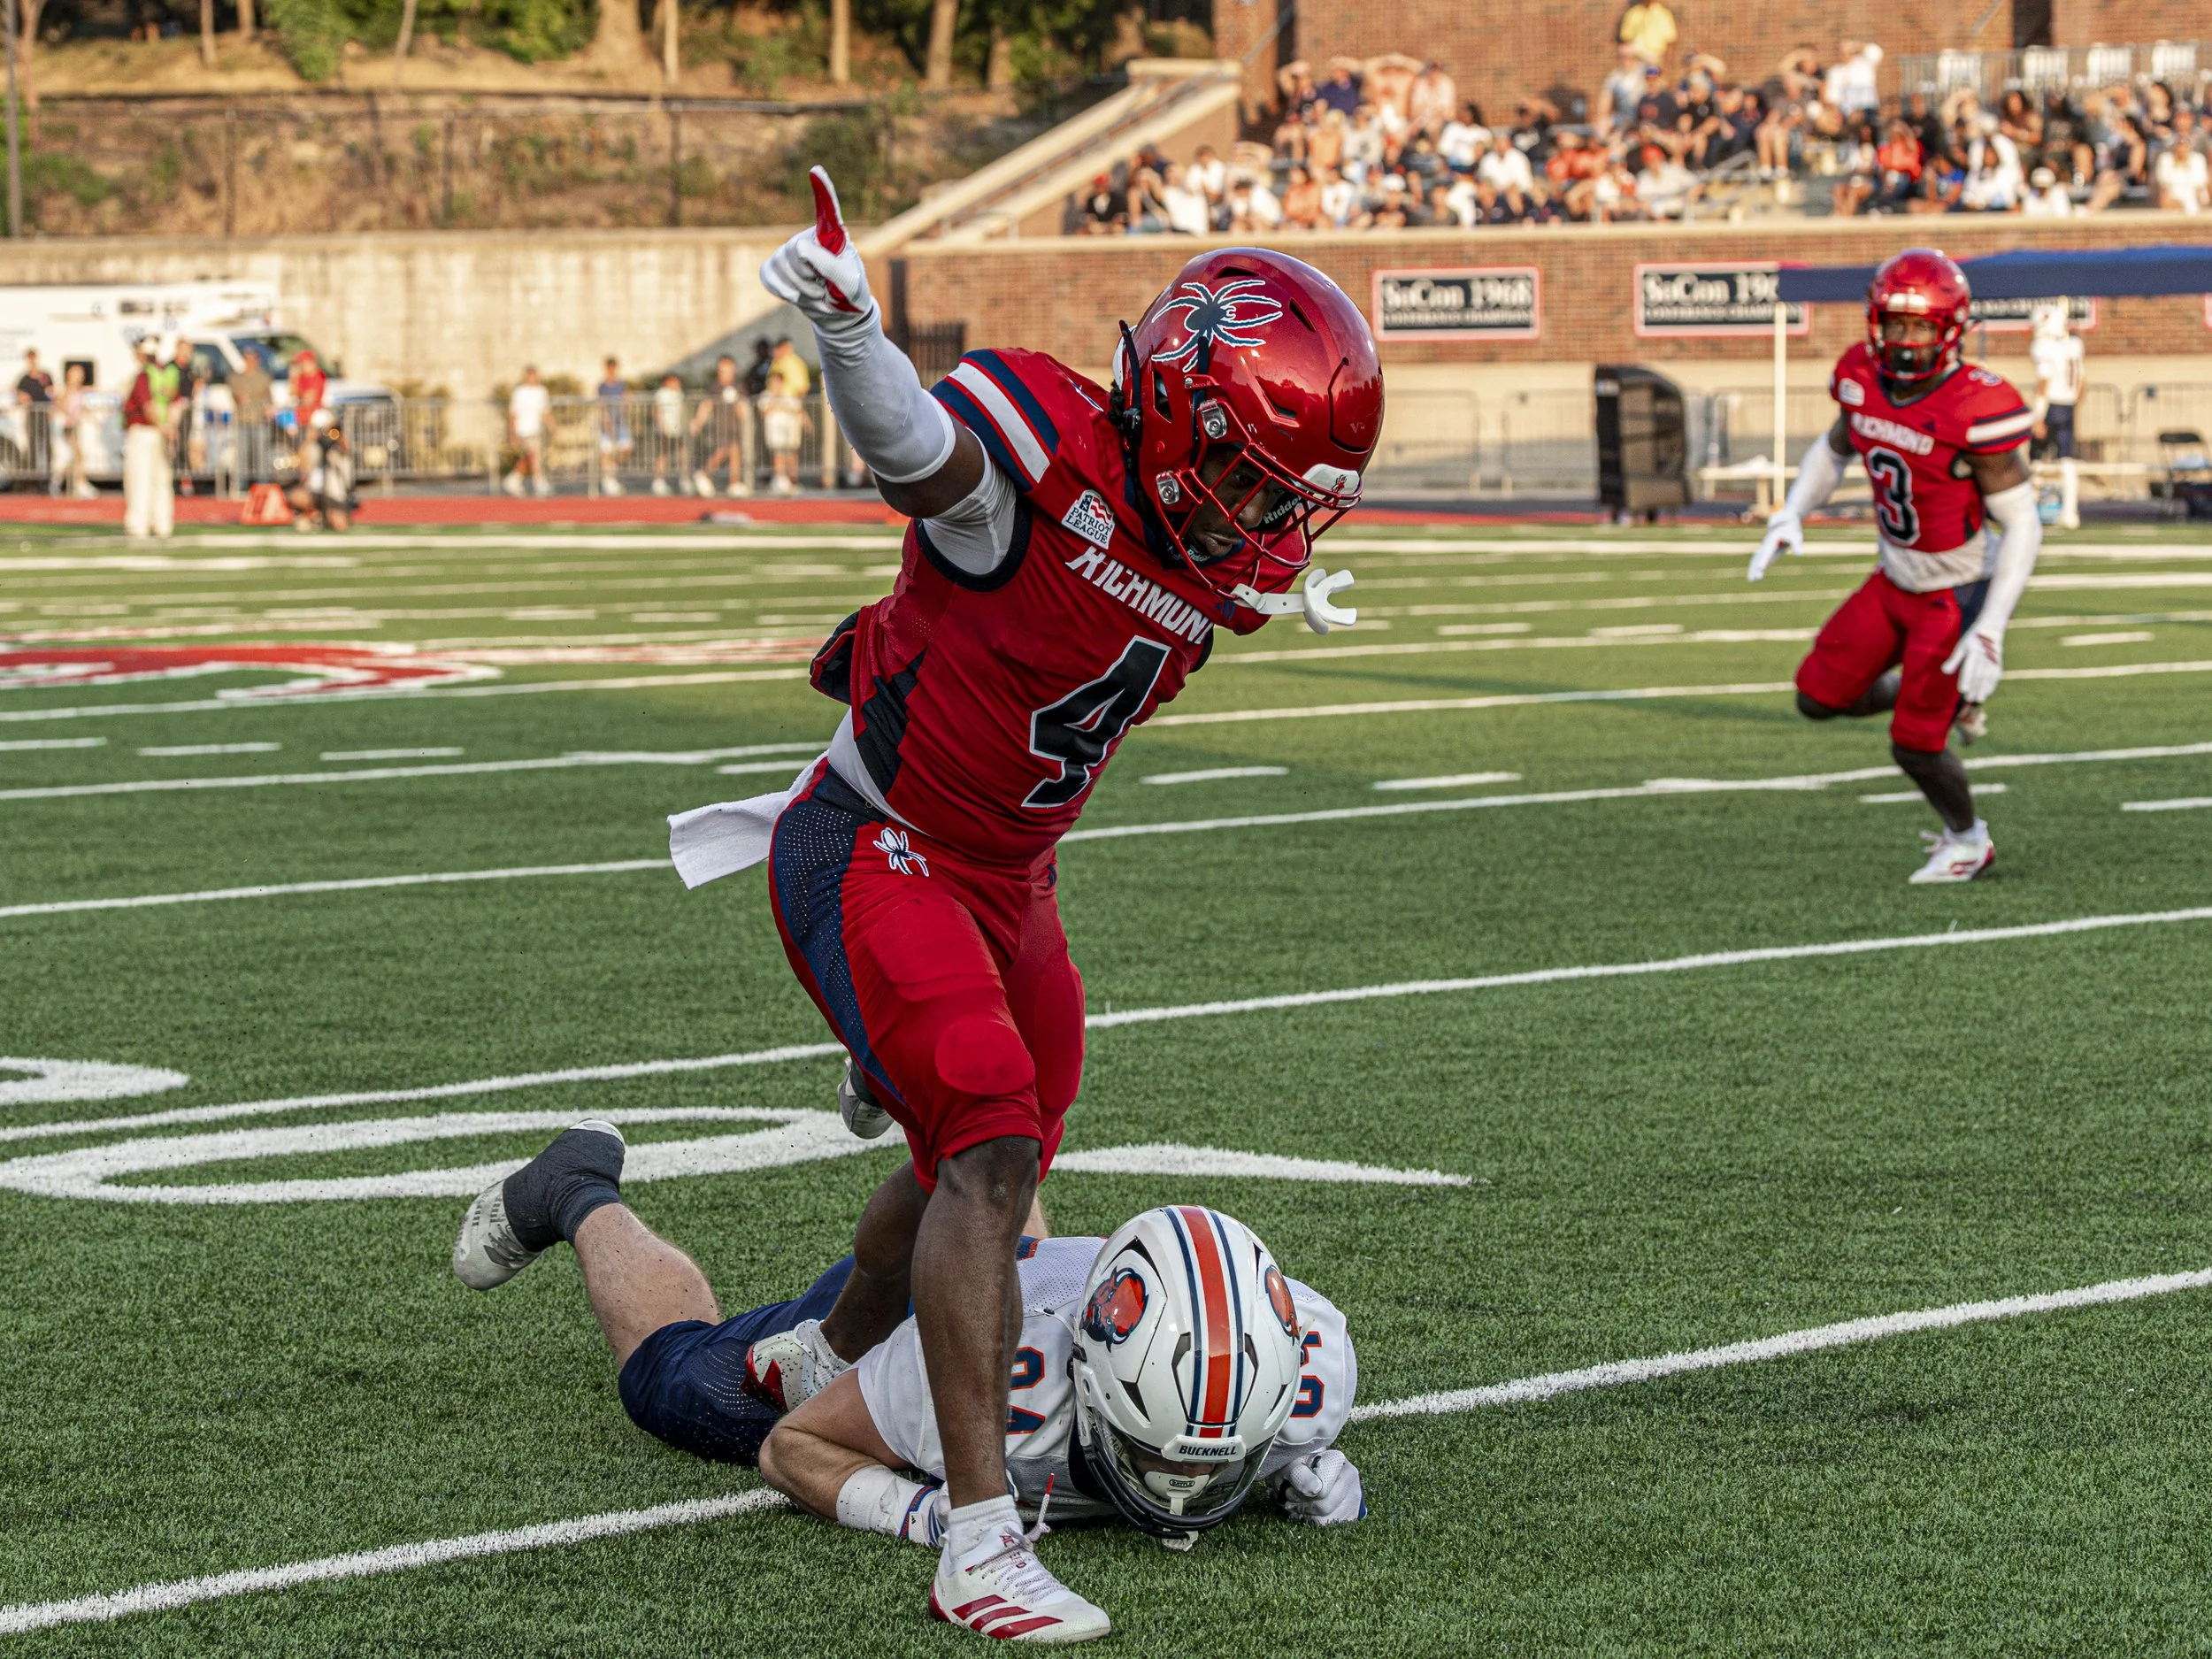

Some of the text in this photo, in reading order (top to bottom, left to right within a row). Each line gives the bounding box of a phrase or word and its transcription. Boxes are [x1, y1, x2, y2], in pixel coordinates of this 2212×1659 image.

[1070, 507, 1111, 536] PATRIOT
[1866, 445, 1921, 547] 3
[1065, 515, 1108, 544] LEAGUE
[1064, 546, 1214, 645] RICHMON
[1021, 635, 1172, 808] 4
[1179, 1445, 1237, 1457] BUCKNELL
